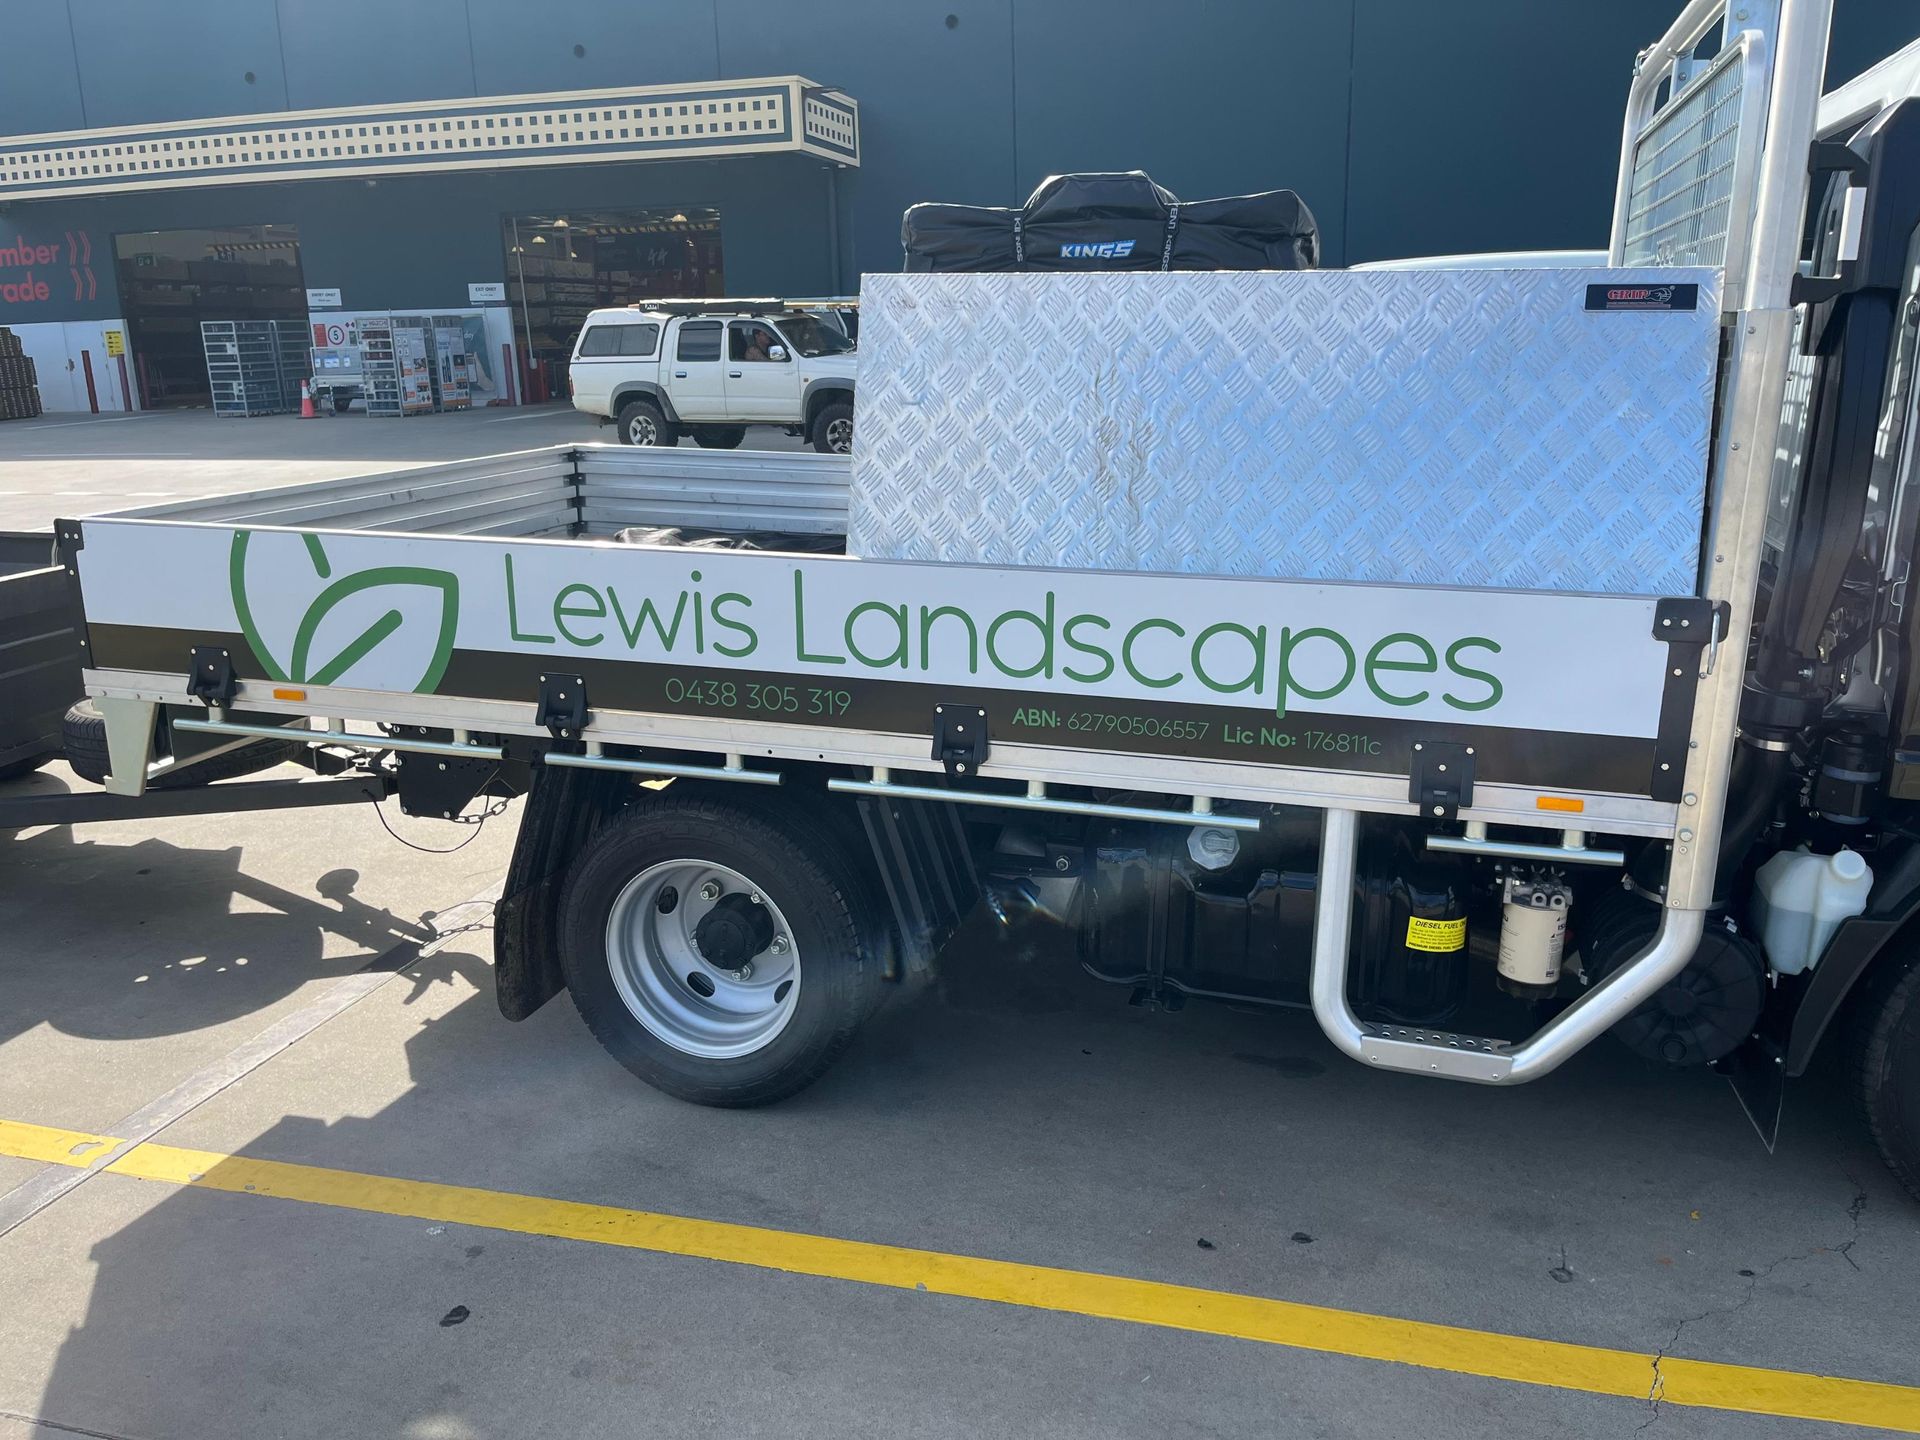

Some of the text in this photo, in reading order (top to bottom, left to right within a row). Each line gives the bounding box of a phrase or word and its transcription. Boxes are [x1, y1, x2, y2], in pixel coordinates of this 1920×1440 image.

[0, 234, 59, 267] mber
[1061, 242, 1135, 258] KINGS
[0, 271, 49, 302] ade
[333, 330, 339, 340] 5
[504, 553, 1504, 719] Lewis Landscapes
[664, 678, 852, 717] 0438 305 319
[1012, 708, 1381, 756] ABN: 62790506557 Lic No: 176811c
[1415, 921, 1441, 929] DIESEL
